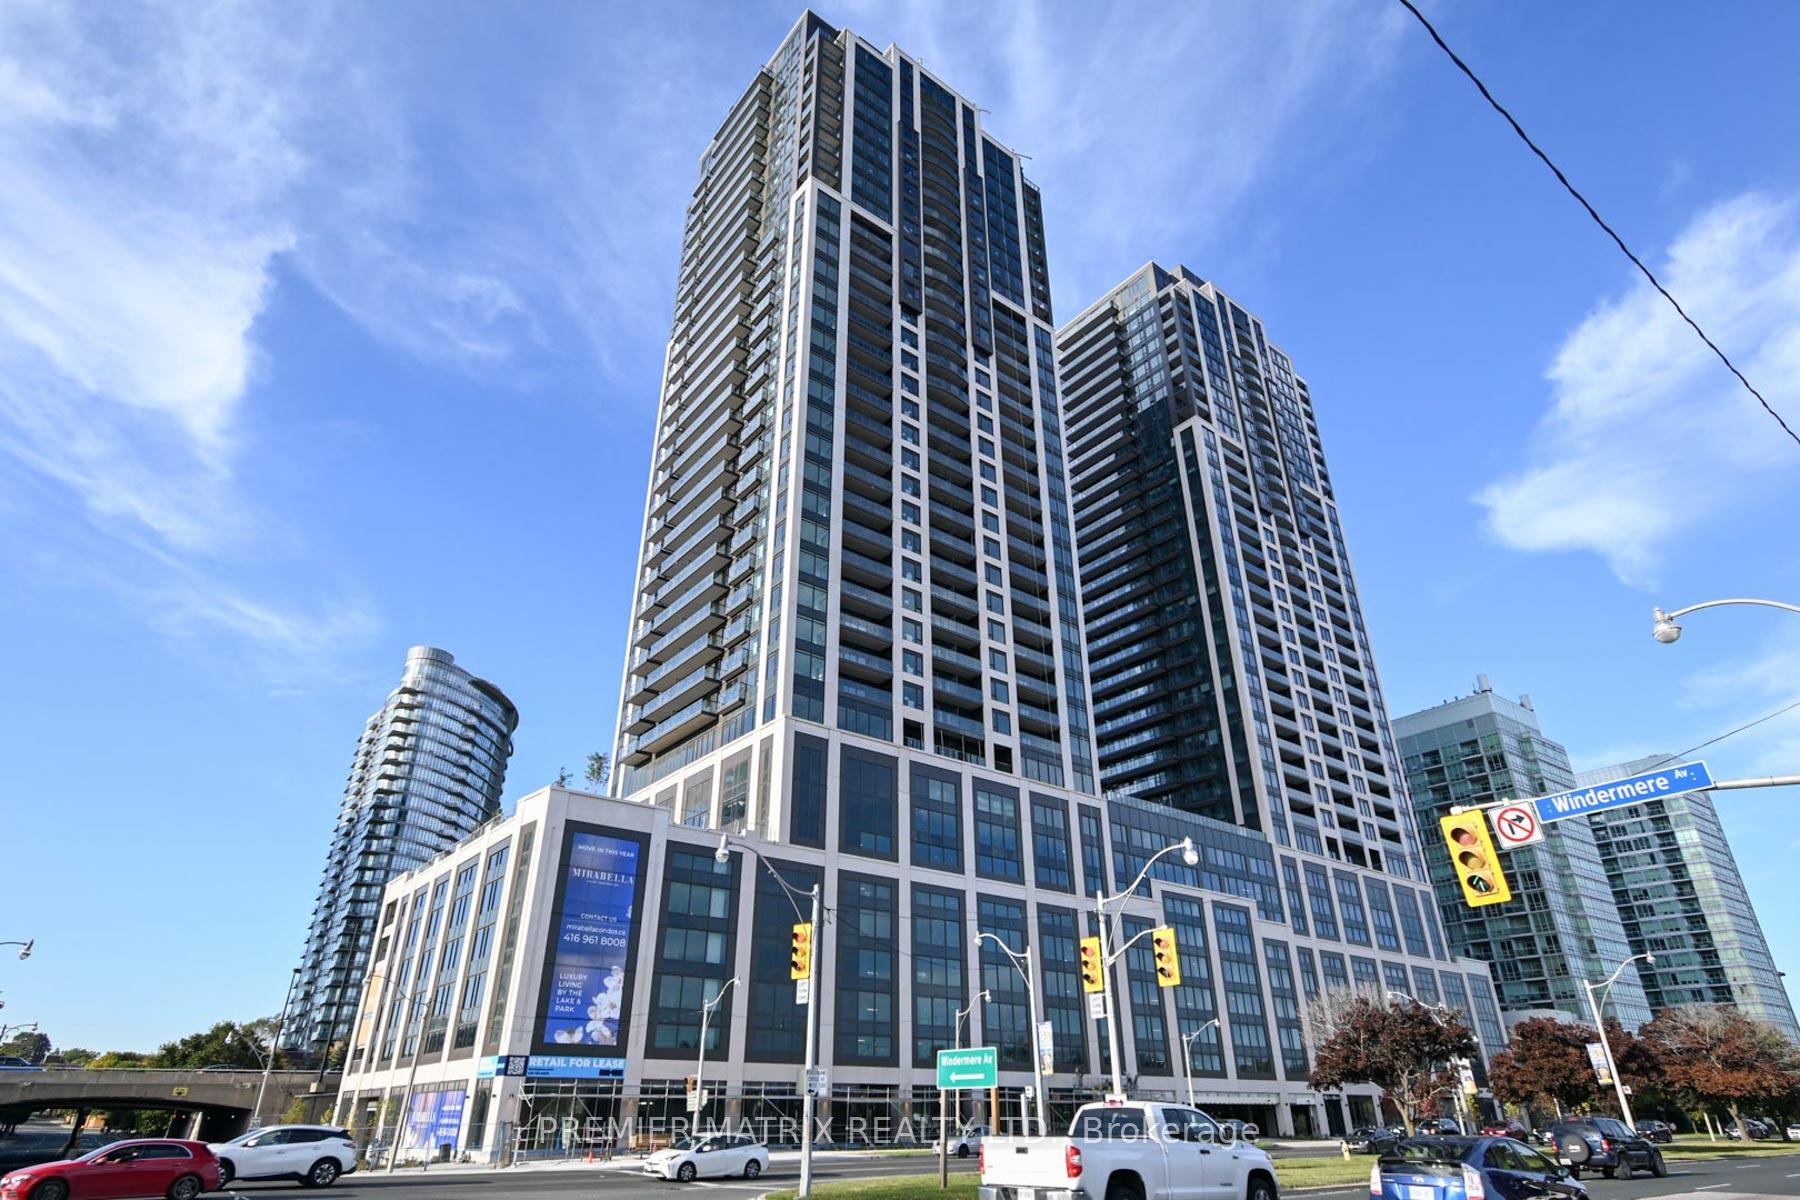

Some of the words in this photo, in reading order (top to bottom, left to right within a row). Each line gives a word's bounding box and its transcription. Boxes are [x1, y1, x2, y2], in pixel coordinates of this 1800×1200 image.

[1552, 776, 1670, 813] Windermere
[1675, 768, 1688, 779] Av
[578, 844, 595, 852] MOVE
[605, 848, 618, 856] THIS
[620, 850, 635, 858] YEAR
[573, 867, 634, 885] MIRABELLA
[581, 912, 608, 921] CONTACT
[566, 923, 626, 935] mirabellacondos.ca
[563, 932, 581, 943] 416
[582, 934, 599, 945] 961
[600, 937, 627, 948] 8008
[560, 972, 588, 981] LUXURY
[559, 980, 583, 989] LIVING
[569, 989, 583, 997] THE
[556, 996, 575, 1004] LAKE
[554, 1005, 575, 1013] PARK
[529, 1056, 566, 1068] RETAIL
[569, 1058, 591, 1069] FOR
[592, 1059, 625, 1070] LEASE
[941, 1054, 983, 1067] Windermere
[983, 1052, 993, 1065] Av
